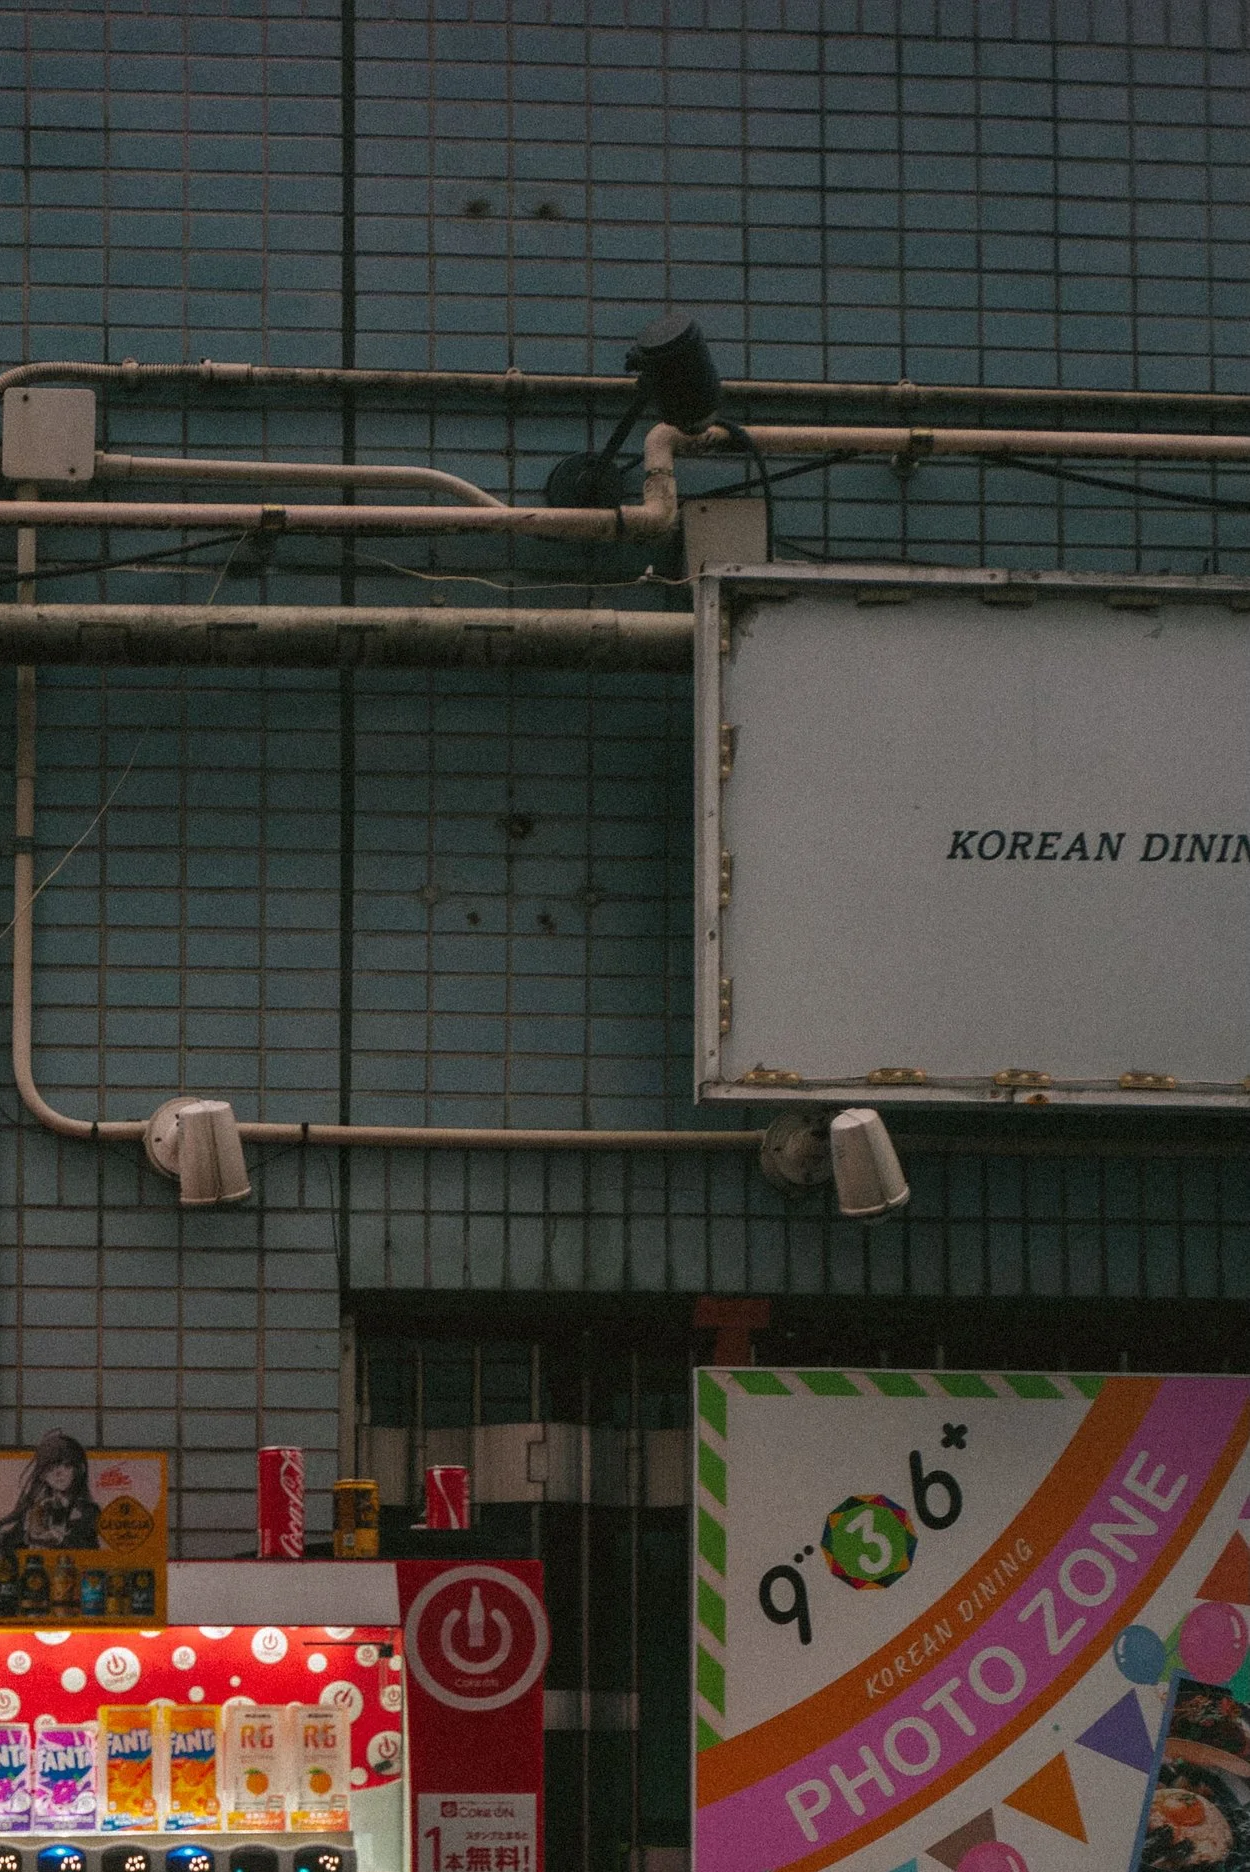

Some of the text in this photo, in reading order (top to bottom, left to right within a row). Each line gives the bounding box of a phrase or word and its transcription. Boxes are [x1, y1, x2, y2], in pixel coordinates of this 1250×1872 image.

[946, 830, 1127, 861] KOREAN
[784, 1448, 1191, 1844] PHOTO ZONE
[865, 1537, 1034, 1699] KOREAN DINING
[424, 1826, 530, 1872] 1本無料!
